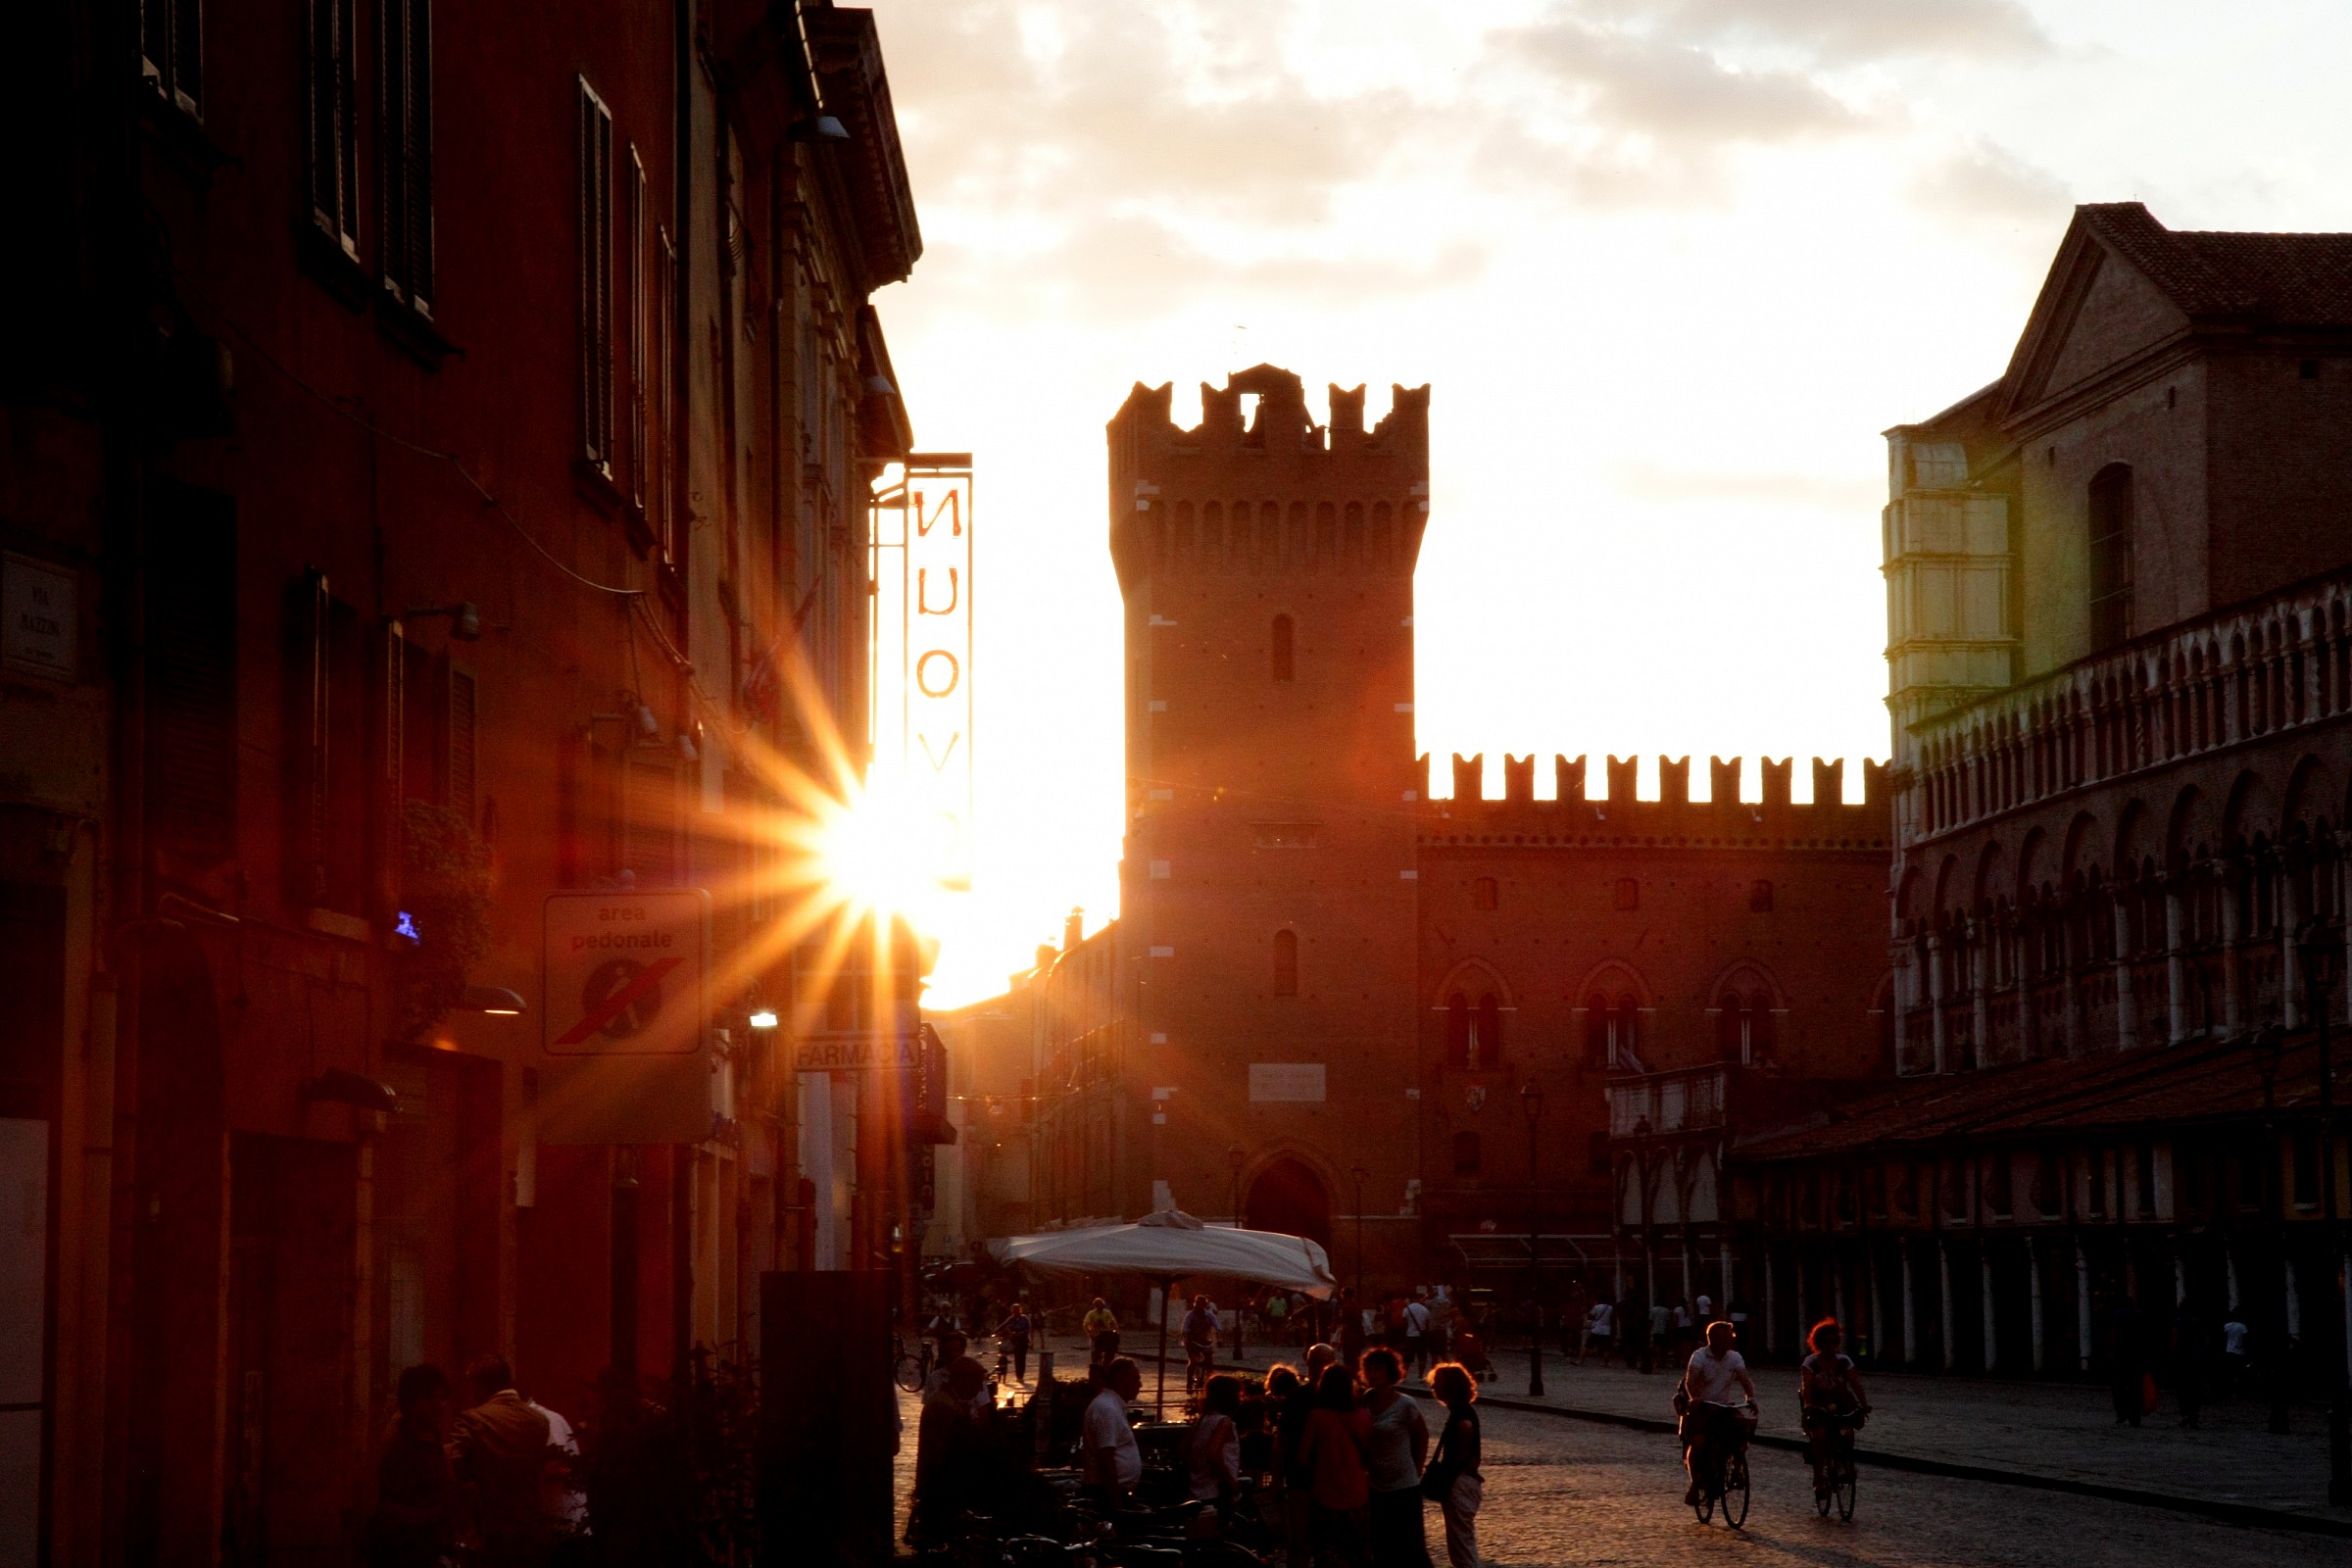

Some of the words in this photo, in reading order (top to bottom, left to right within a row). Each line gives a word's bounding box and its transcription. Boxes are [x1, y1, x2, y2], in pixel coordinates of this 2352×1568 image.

[599, 906, 647, 921] area
[571, 929, 673, 952] pedonale
[798, 1042, 913, 1066] FARMACIA
